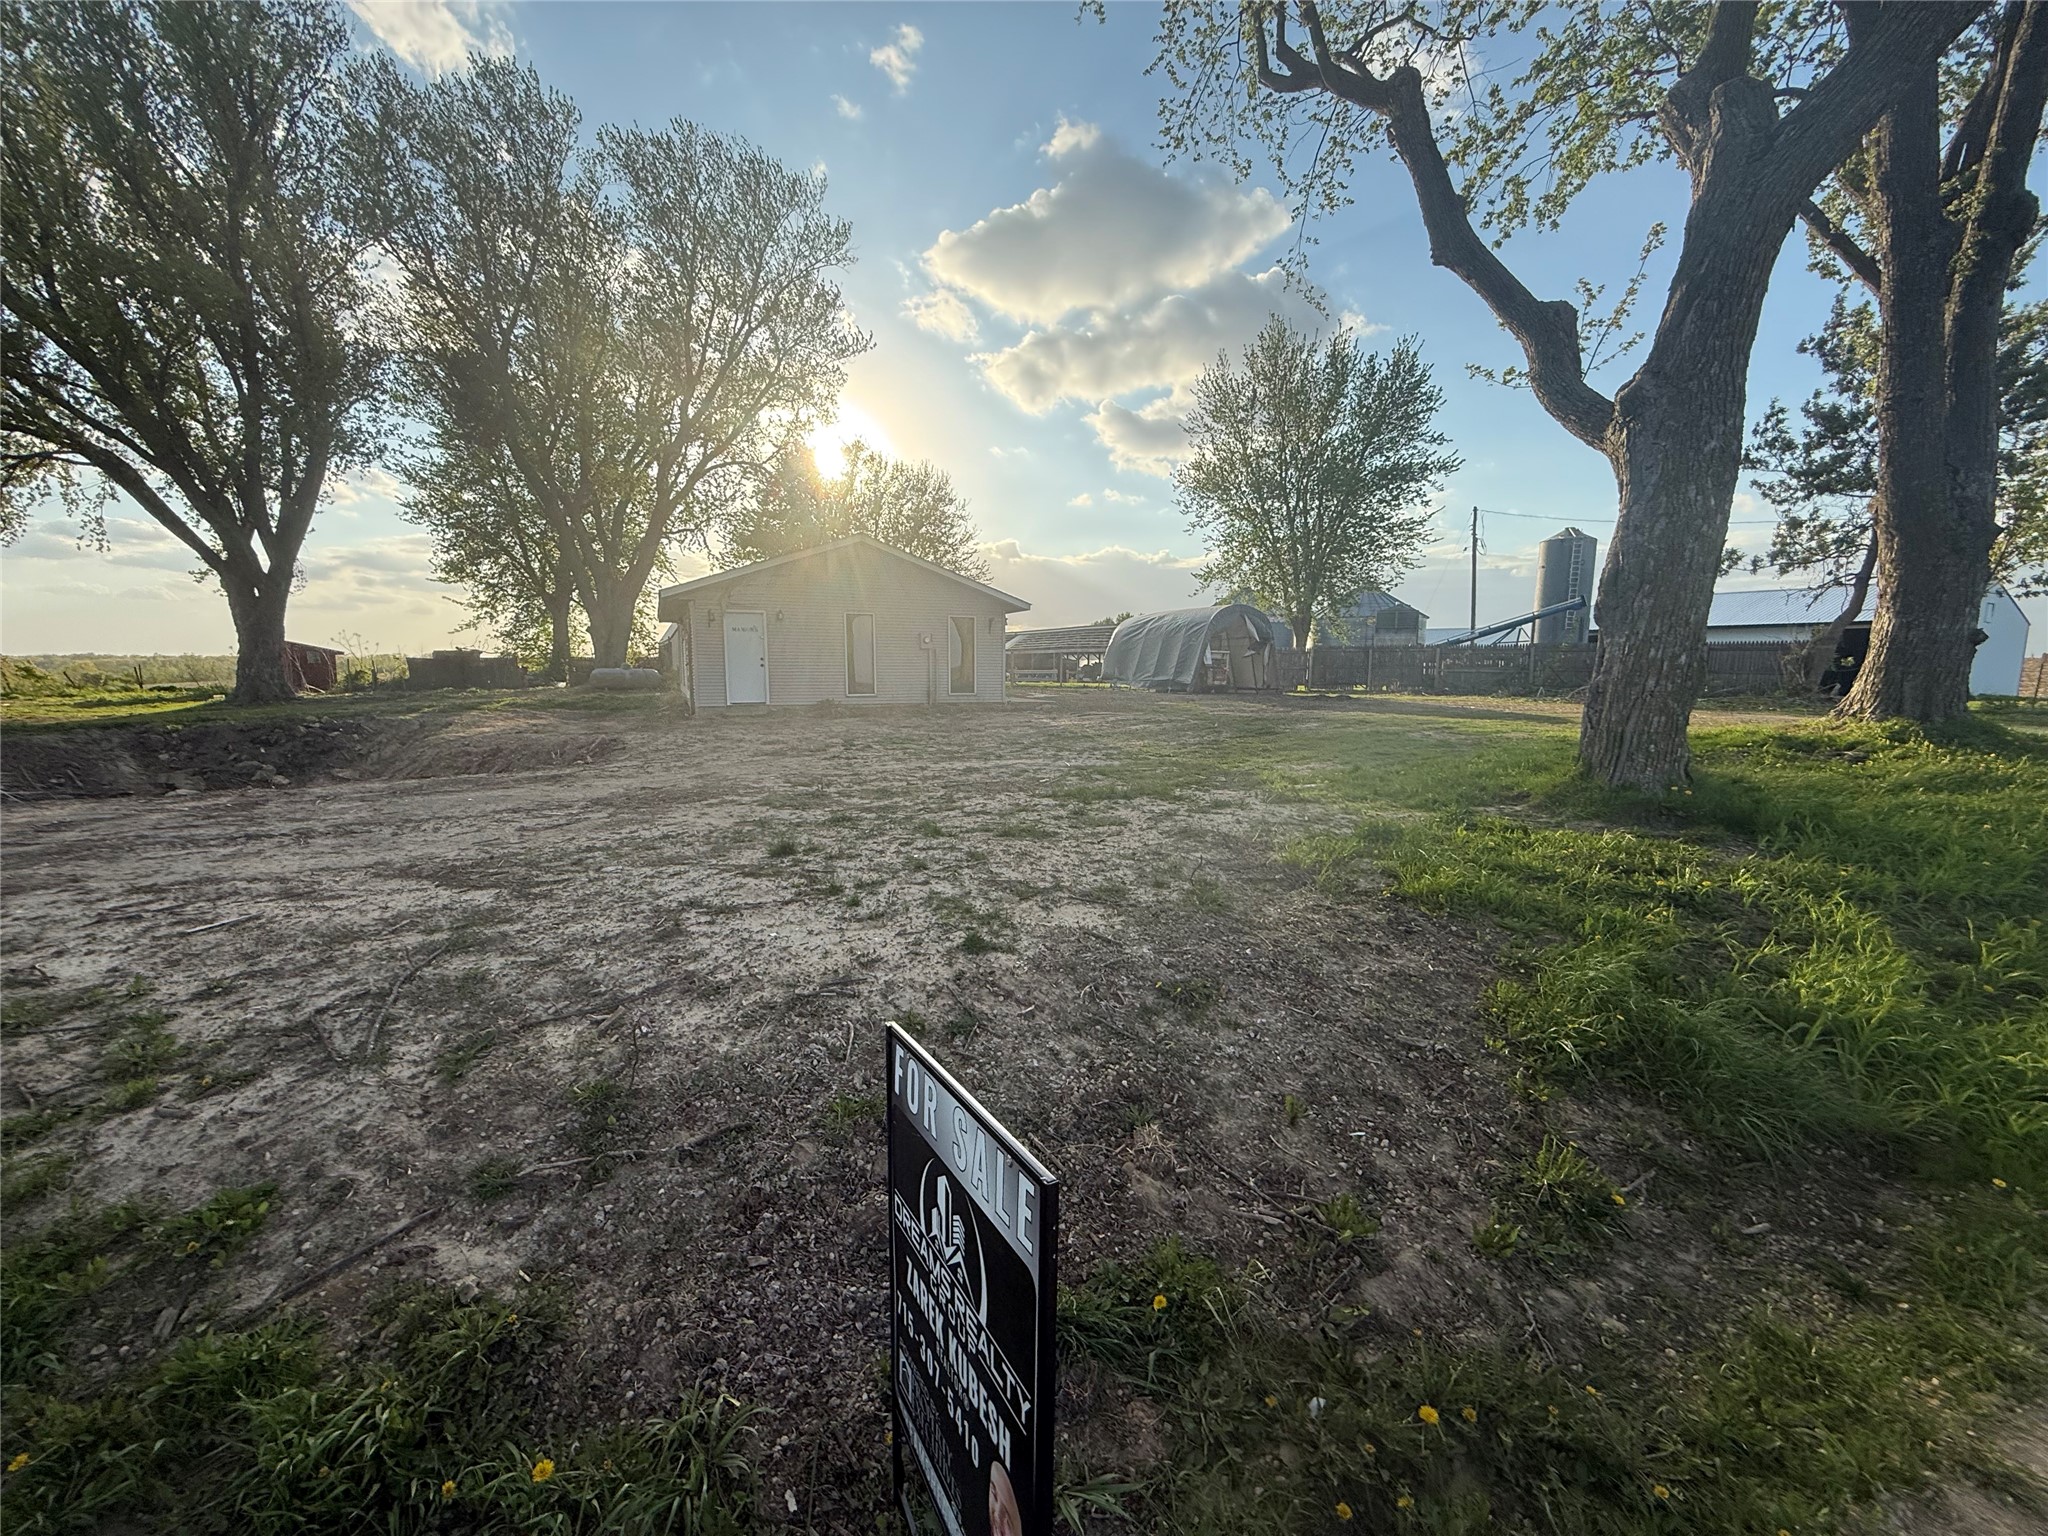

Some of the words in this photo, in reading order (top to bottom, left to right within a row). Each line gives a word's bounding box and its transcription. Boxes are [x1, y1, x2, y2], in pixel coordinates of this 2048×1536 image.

[894, 1043, 938, 1141] FOR
[952, 1106, 1036, 1256] SALE
[894, 1194, 951, 1299] DREAMS
[954, 1288, 1031, 1424] REALTY
[897, 1290, 979, 1469] 715-307-5410
[907, 1255, 944, 1350] ZAREK
[948, 1327, 1011, 1471] KUBESH
[930, 1274, 976, 1354] GROUP
